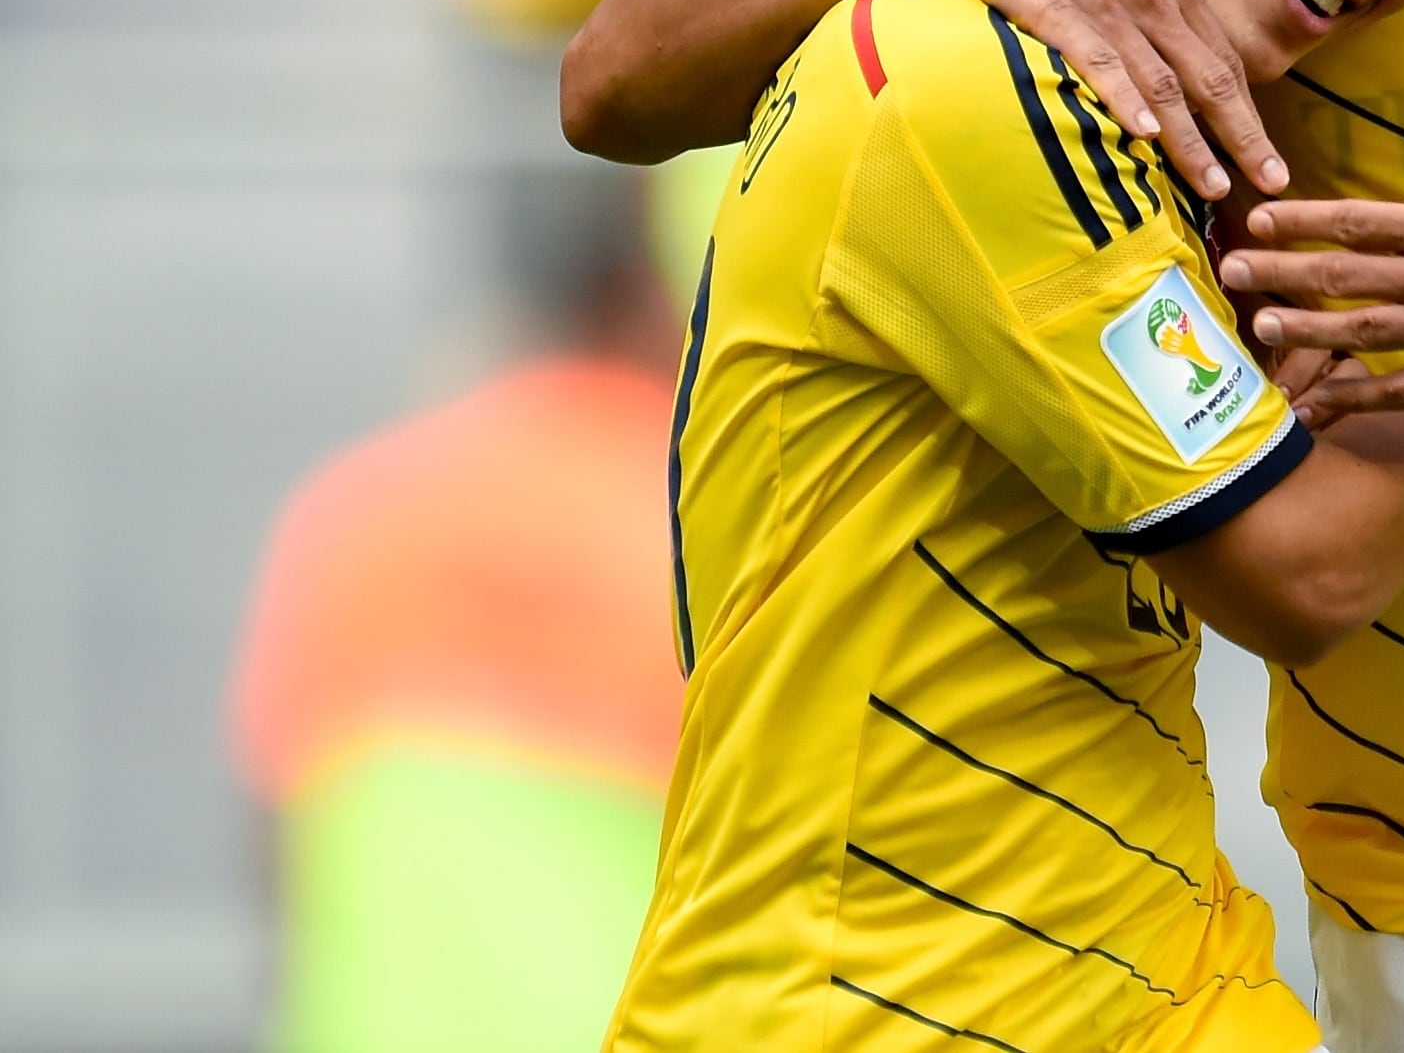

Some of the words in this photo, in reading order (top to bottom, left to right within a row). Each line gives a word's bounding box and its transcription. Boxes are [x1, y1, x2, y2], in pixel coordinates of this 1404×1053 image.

[1183, 409, 1208, 430] FIFA
[1206, 379, 1234, 412] WORLD
[1232, 366, 1243, 383] CUP
[1214, 395, 1244, 424] Brasil
